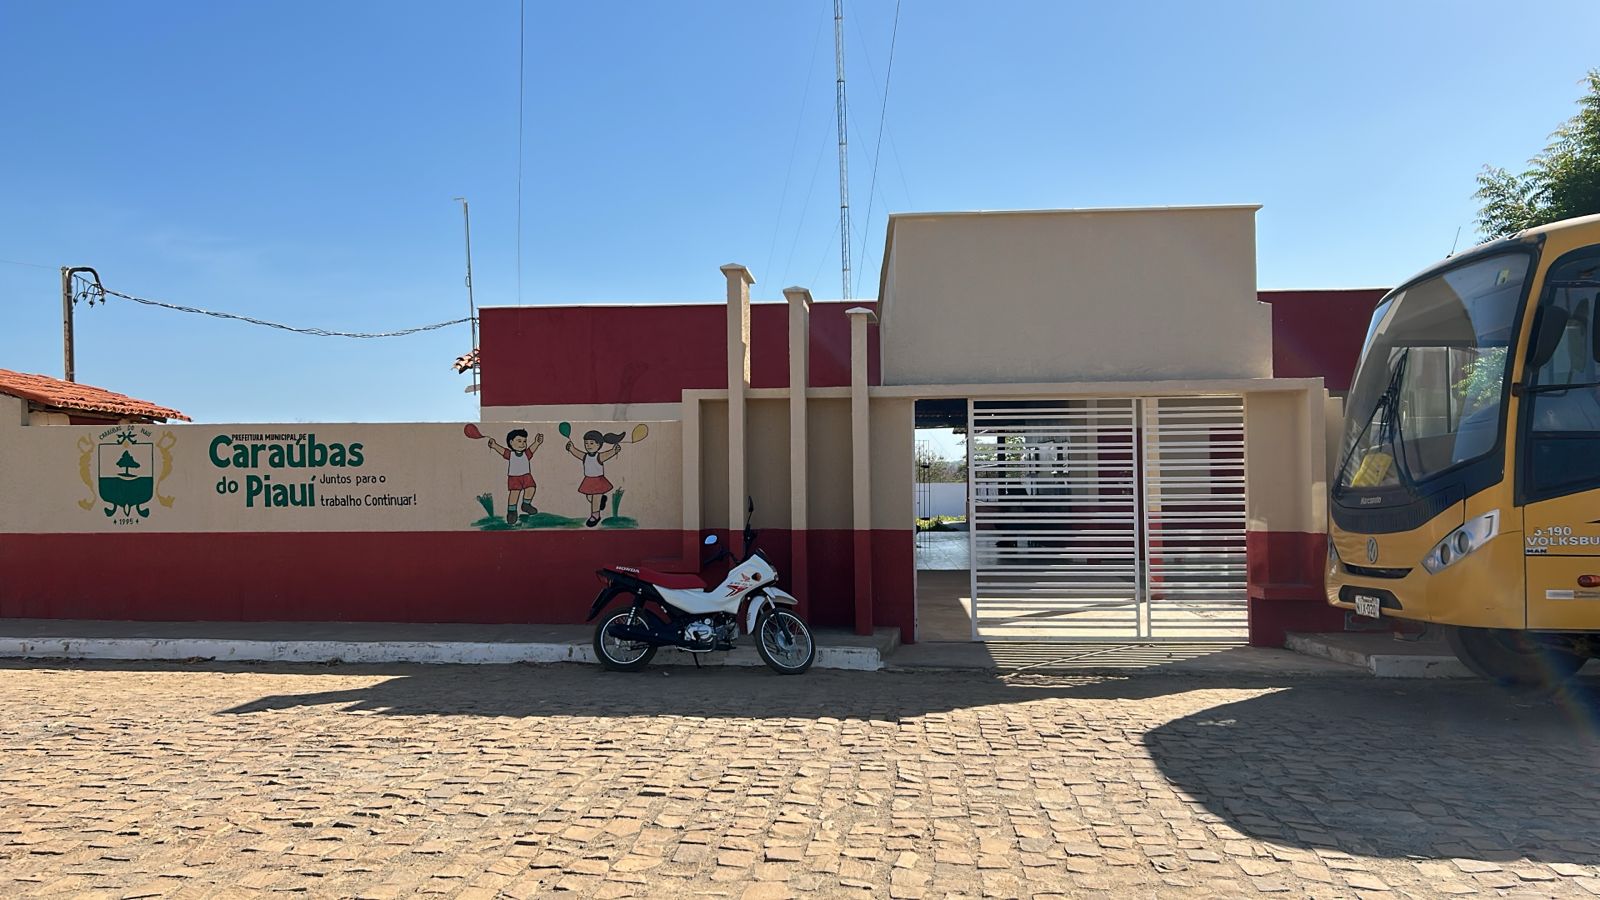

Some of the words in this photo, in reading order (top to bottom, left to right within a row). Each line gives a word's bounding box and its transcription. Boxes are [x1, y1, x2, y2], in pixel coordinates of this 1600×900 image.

[231, 433, 264, 441] PREFEITURA
[264, 433, 297, 441] MUNICIPAL
[208, 434, 364, 468] Caraúbas
[319, 473, 352, 485] Juntos
[355, 475, 377, 486] para
[379, 475, 386, 483] o
[216, 476, 239, 495] do
[246, 474, 316, 508] Piauí
[320, 494, 362, 507] trabalho
[364, 493, 417, 507] Continuar!
